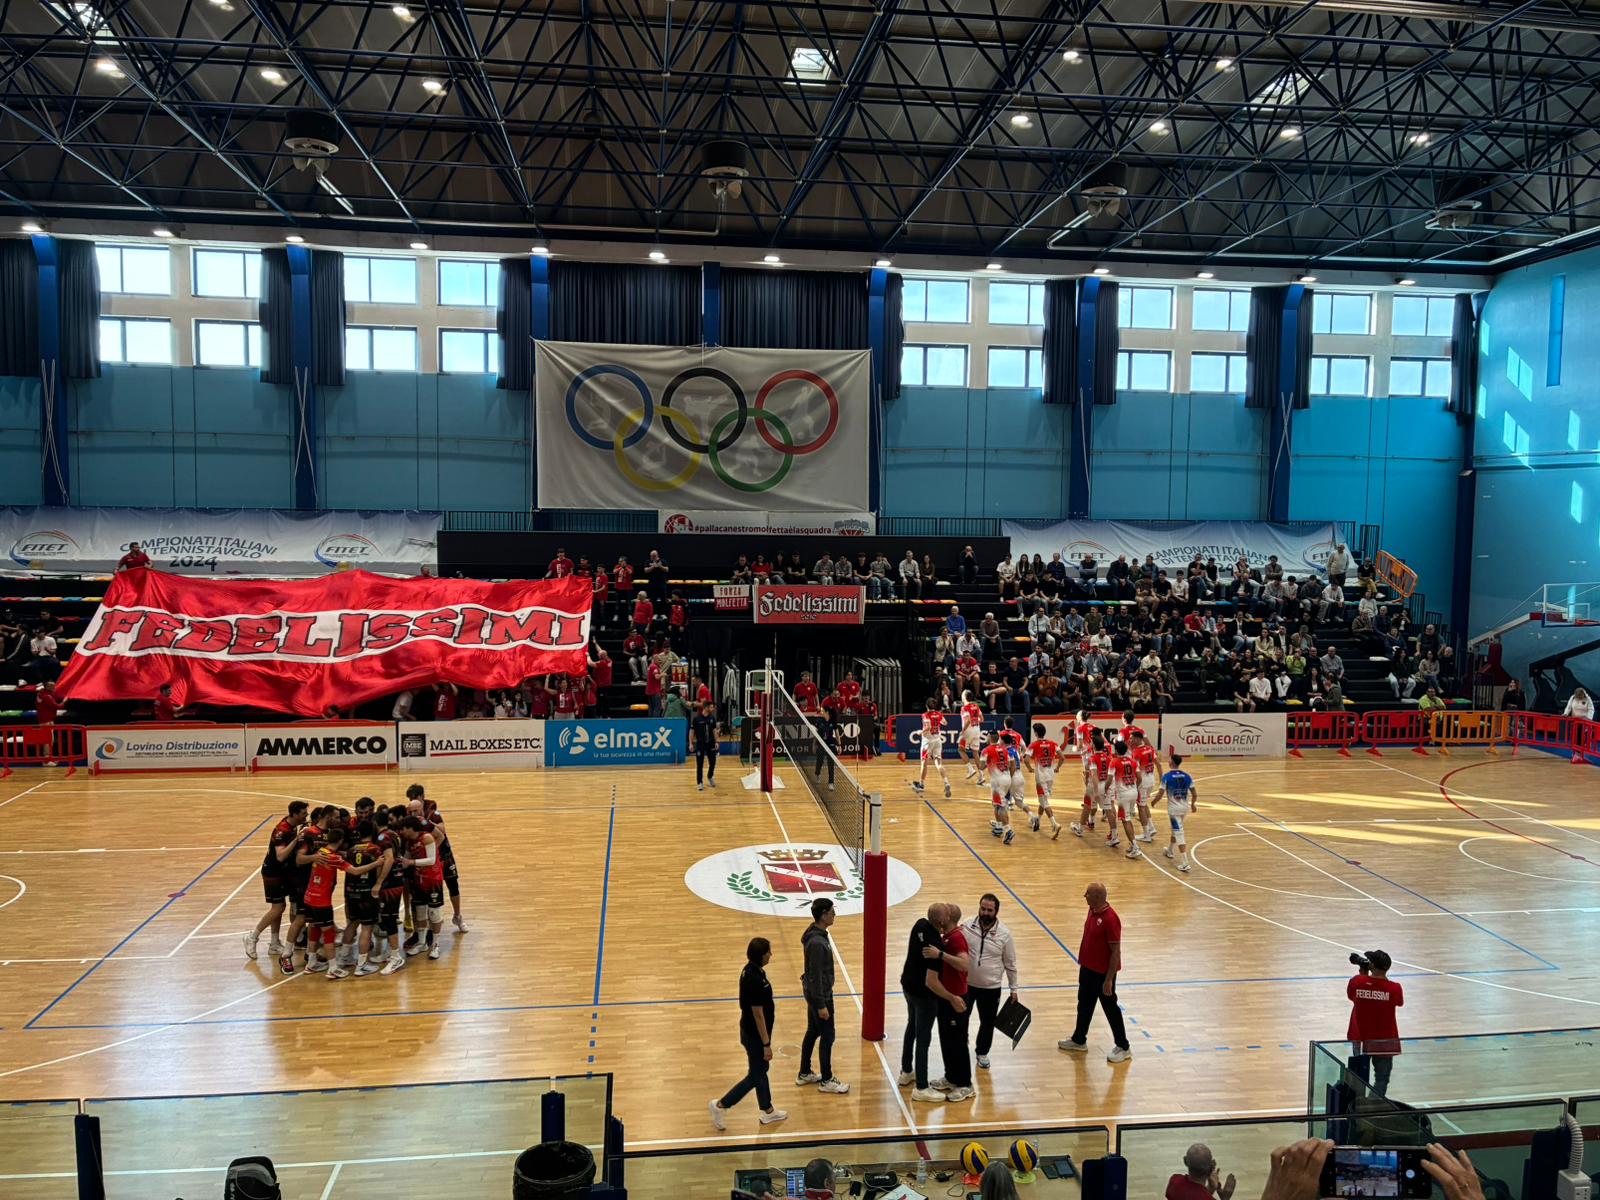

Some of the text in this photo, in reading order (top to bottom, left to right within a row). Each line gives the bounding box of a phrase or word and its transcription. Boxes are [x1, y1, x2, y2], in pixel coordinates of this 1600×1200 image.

[21, 543, 69, 552] FITET
[120, 535, 278, 555] CMPIONATI ITALIANI
[149, 545, 262, 559] TENNISTAVOLO
[325, 546, 369, 554] FITET
[169, 555, 218, 571] 2024
[719, 586, 742, 596] FORZA
[716, 597, 748, 608] MOLFETTA
[759, 590, 859, 616] Fedelissimi
[84, 608, 585, 657] FEDELISSIMI
[126, 740, 239, 751] Lovino Distribuzione
[430, 737, 542, 751] MAIL BOXES ETC.
[593, 727, 672, 750] elmax
[256, 736, 387, 756] AMMERCO
[355, 852, 362, 864] 8
